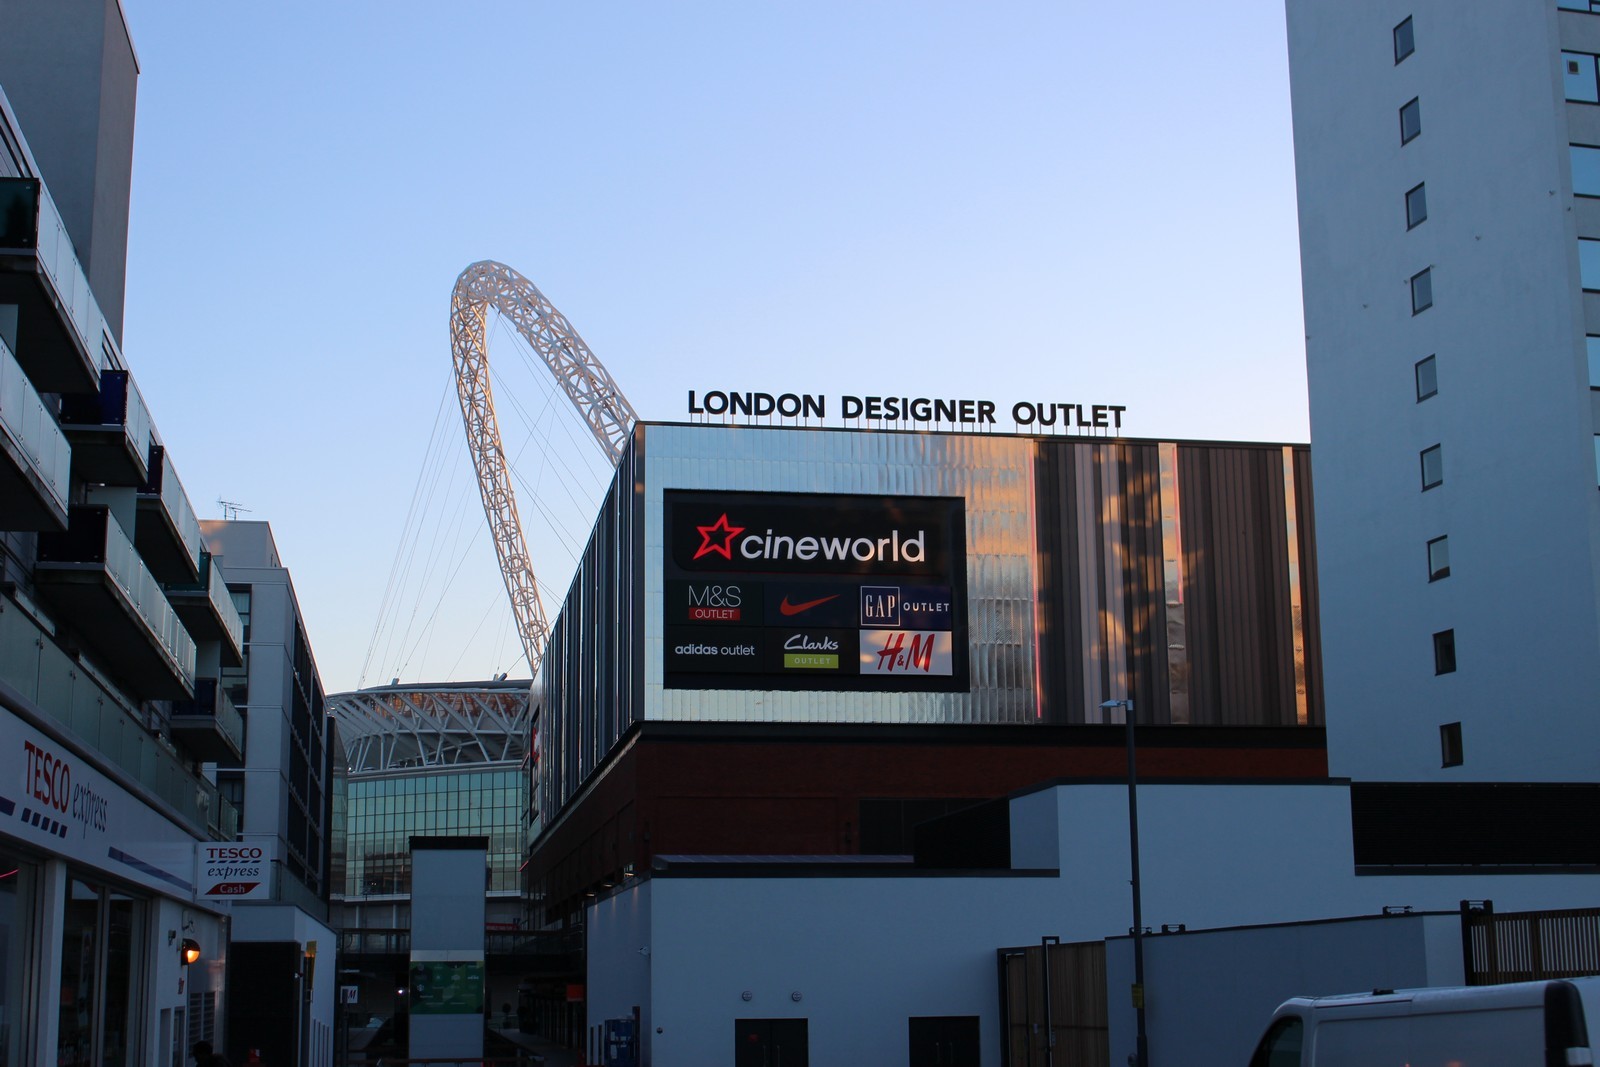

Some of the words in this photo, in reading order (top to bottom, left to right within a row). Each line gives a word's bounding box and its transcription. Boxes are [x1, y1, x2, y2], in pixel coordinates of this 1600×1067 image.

[688, 390, 825, 418] LONDON
[841, 395, 997, 423] DESIGNER
[1011, 401, 1127, 428] OUTLET
[740, 528, 925, 562] cineworld
[688, 585, 742, 608] M&S
[694, 609, 735, 619] OUTLET
[865, 594, 896, 618] GAP
[903, 602, 950, 612] OUTLET
[674, 643, 719, 655] adidas
[720, 645, 756, 656] outlet
[783, 633, 839, 650] Clarks
[794, 657, 831, 665] OUTLET
[876, 632, 936, 673] H&M
[24, 739, 71, 814] TESCO
[72, 781, 108, 840] express
[205, 847, 263, 859] TESCO
[207, 866, 260, 880] express
[219, 884, 246, 894] Cash
